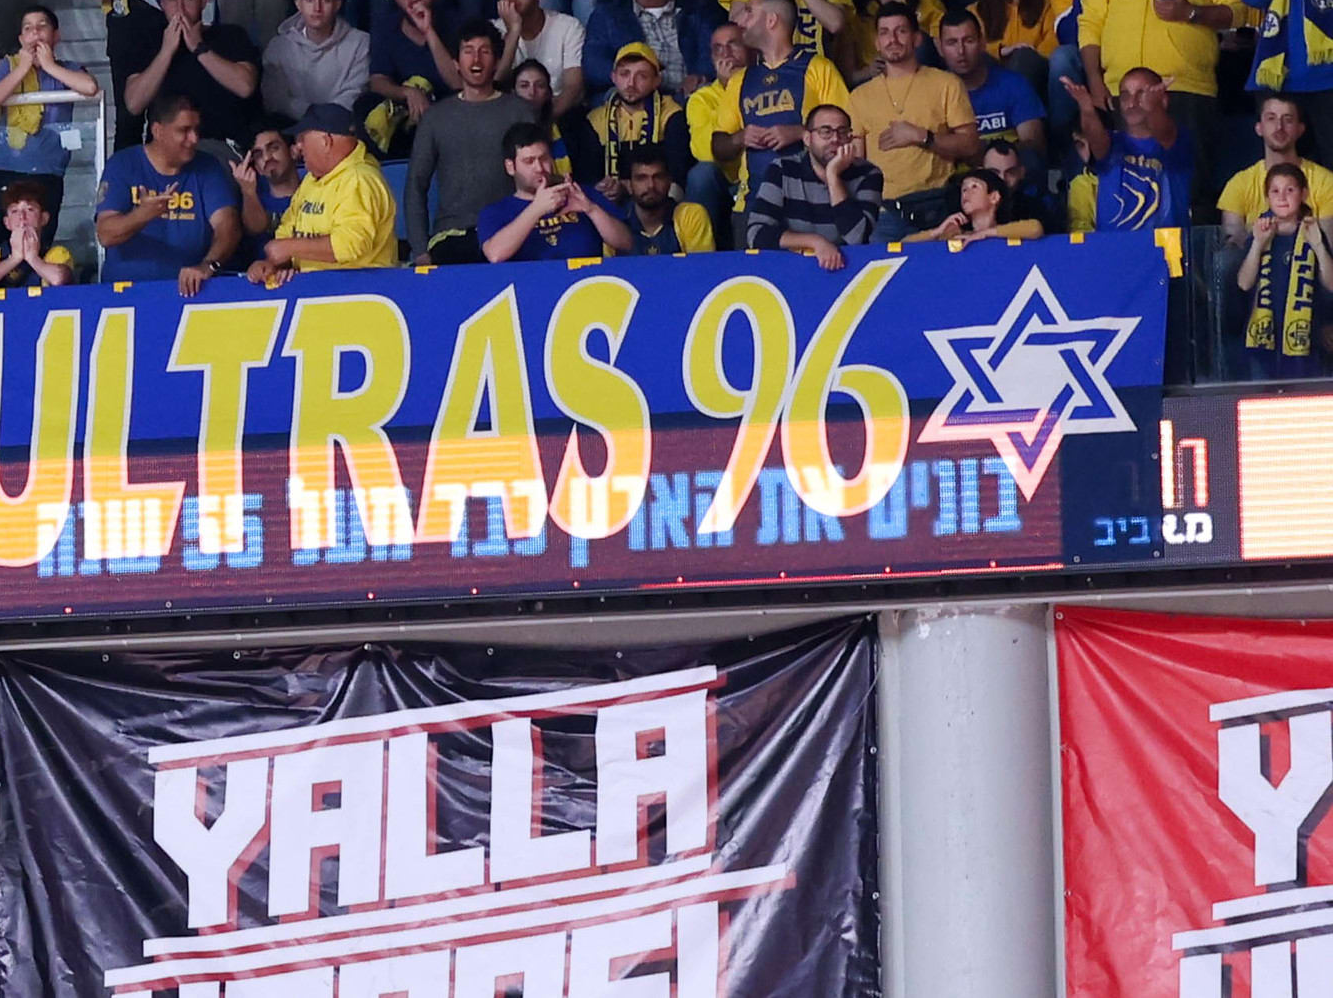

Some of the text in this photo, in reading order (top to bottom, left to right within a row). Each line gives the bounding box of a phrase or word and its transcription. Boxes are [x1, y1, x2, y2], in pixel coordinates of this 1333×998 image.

[743, 90, 796, 116] MTA
[681, 256, 911, 534] 96
[154, 689, 718, 931] YALLA
